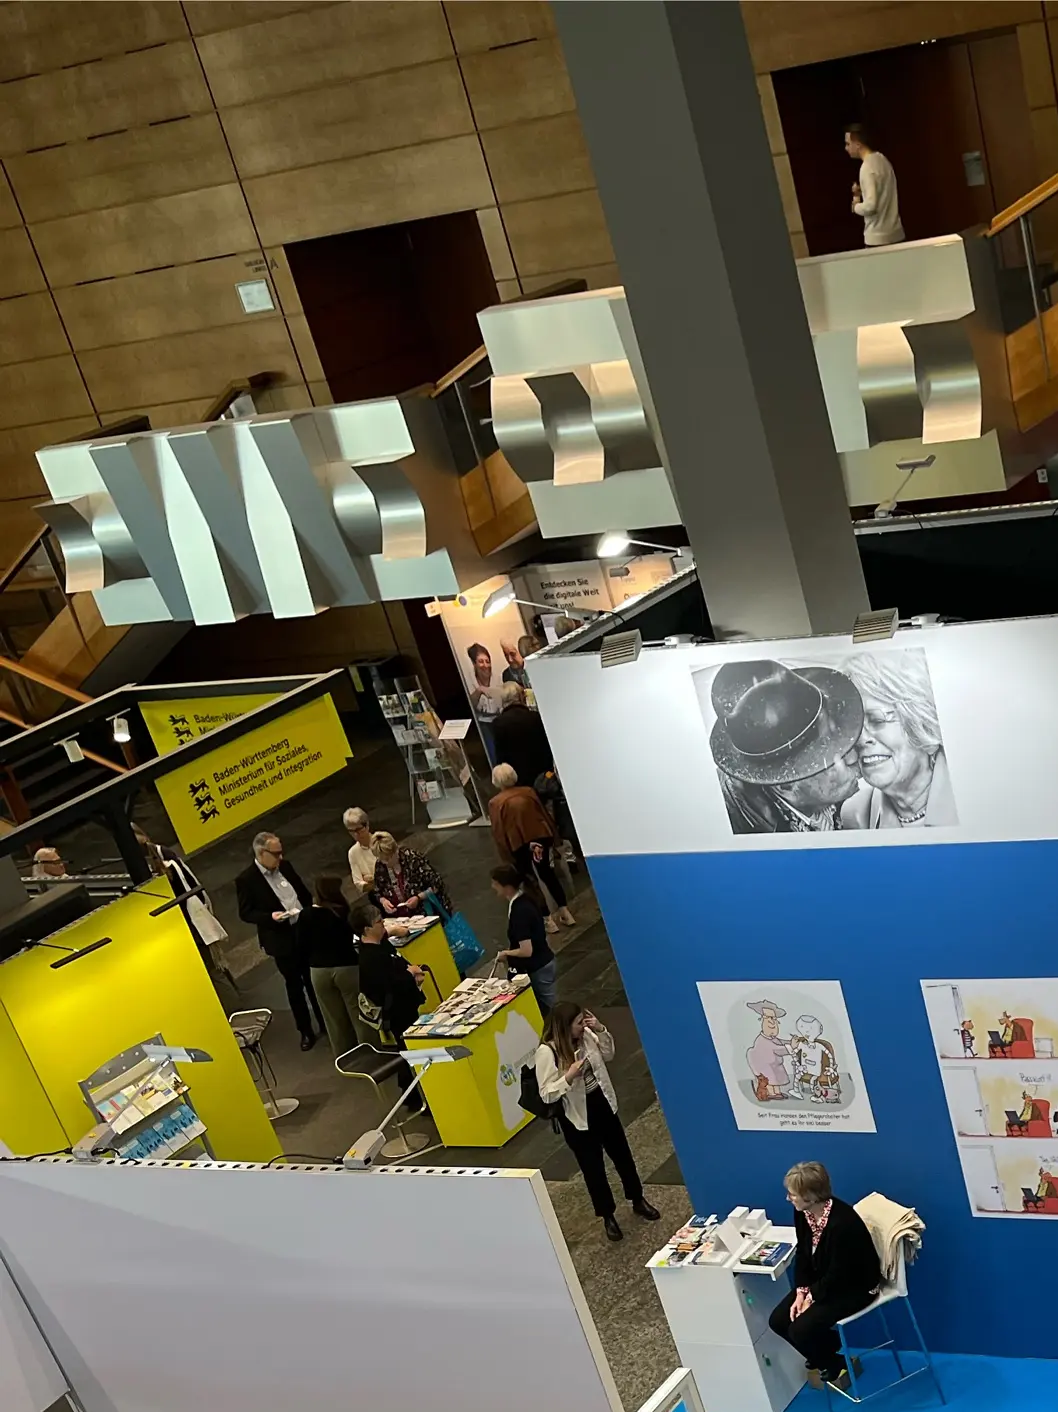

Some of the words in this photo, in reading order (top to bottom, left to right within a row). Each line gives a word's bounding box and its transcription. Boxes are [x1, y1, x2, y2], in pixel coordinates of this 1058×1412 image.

[544, 592, 555, 600] die
[556, 589, 581, 600] digitale
[213, 737, 290, 783] Baden-Württemberg
[218, 762, 265, 796] Ministerium
[276, 744, 309, 767] Soziales,
[224, 779, 268, 809] Gesundheit
[269, 771, 283, 787] und
[283, 750, 323, 778] Integration
